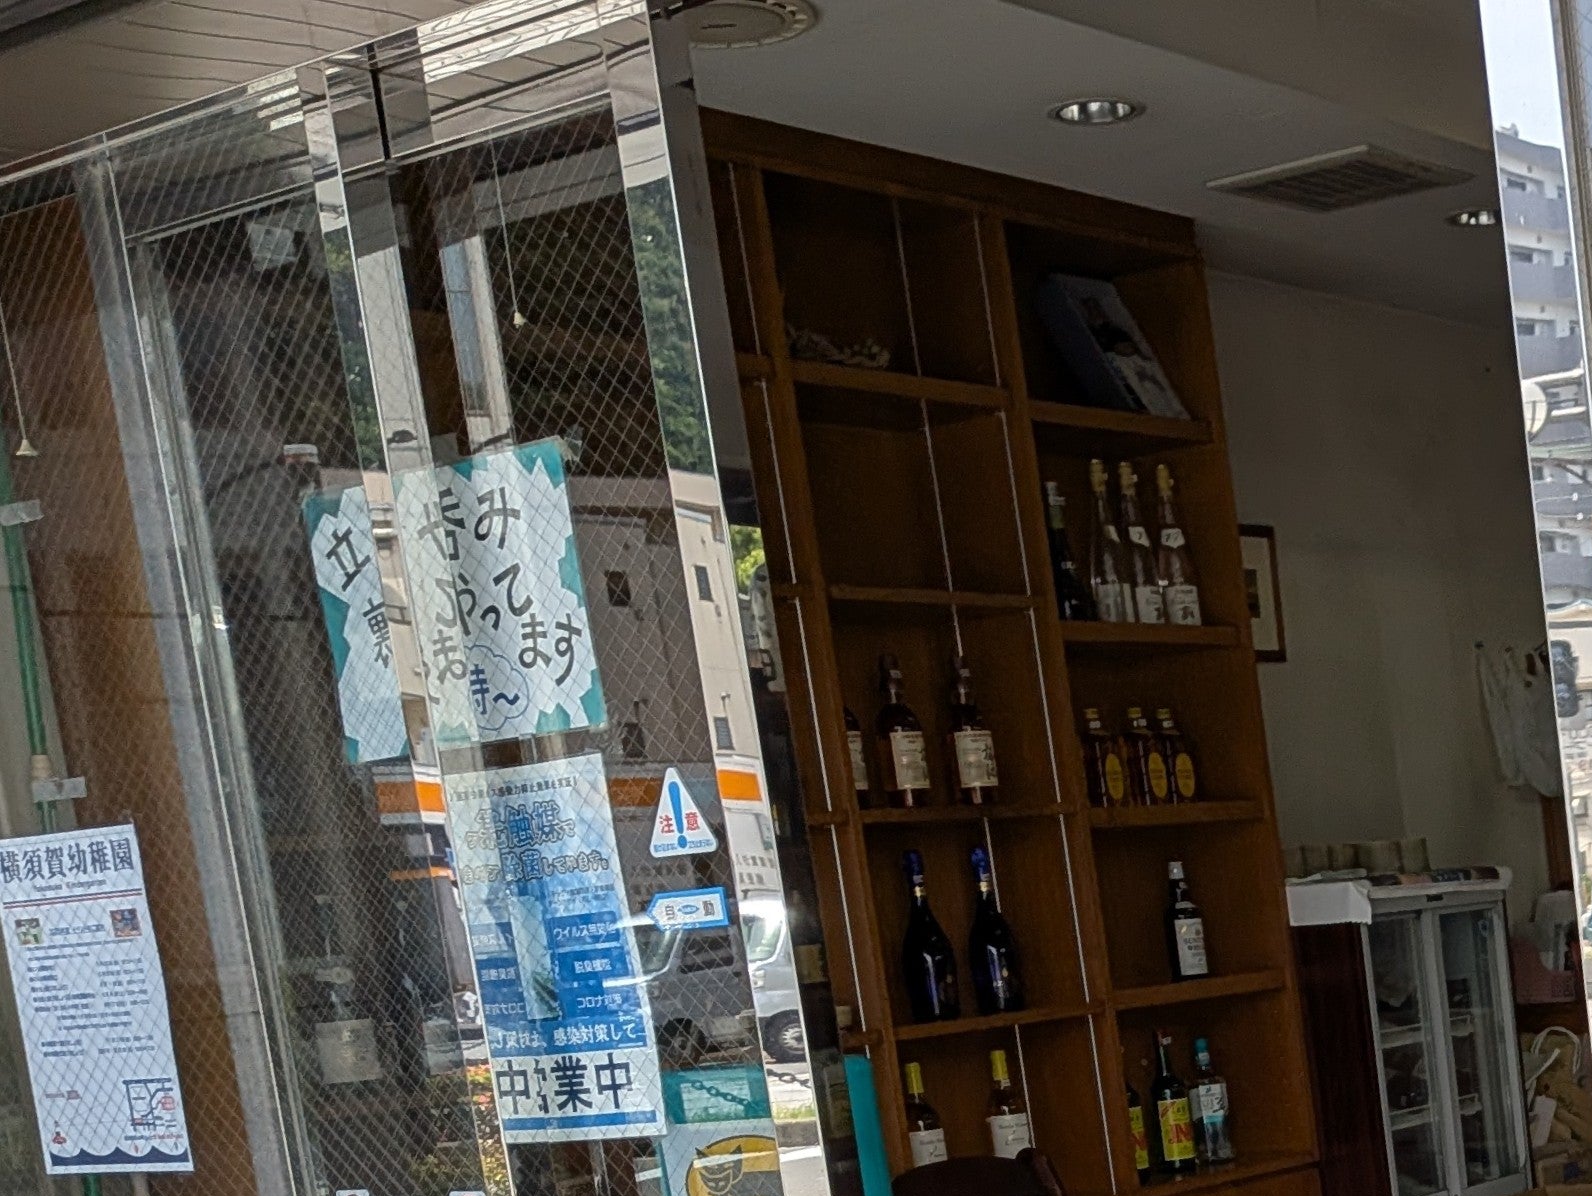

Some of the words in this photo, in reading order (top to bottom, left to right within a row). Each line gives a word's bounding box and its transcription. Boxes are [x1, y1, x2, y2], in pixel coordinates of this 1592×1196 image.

[0, 836, 135, 885] 横須賀幼稚園
